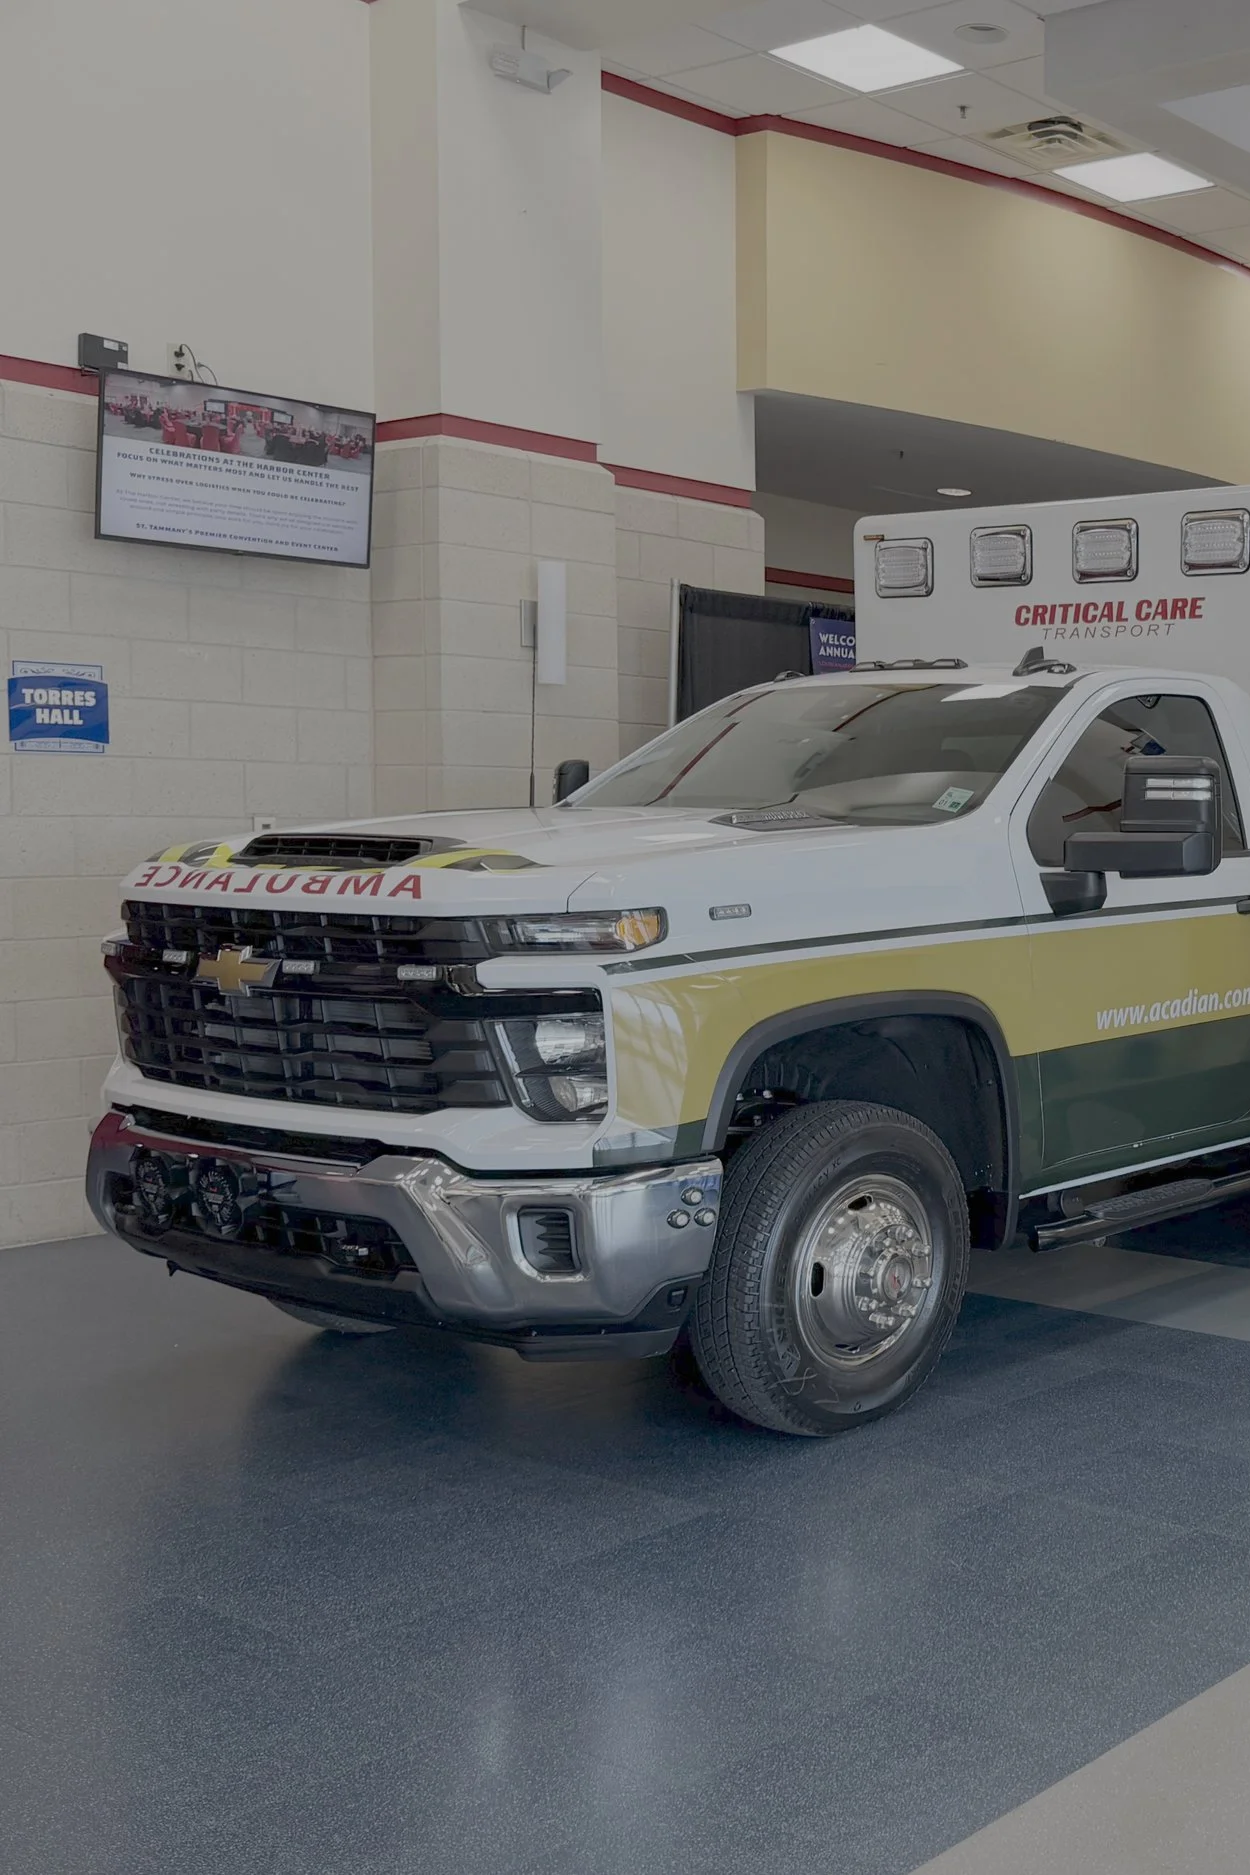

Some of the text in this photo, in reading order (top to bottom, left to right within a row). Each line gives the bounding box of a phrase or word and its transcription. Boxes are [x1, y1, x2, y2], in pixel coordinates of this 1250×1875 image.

[117, 451, 143, 462] FOCUS
[160, 458, 183, 467] WHAT
[186, 462, 223, 473] MATTERS
[225, 468, 247, 477] MOST
[249, 471, 265, 479] AND
[294, 478, 323, 487] HANDLE
[341, 485, 359, 493] REST
[149, 447, 330, 480] CELEBRATIONS AT THE HARBOR CENTER
[148, 475, 174, 483] STRESS
[175, 478, 193, 486] OVER
[195, 482, 230, 491] LOGISTICS
[231, 486, 251, 494] WHEN
[267, 491, 288, 499] COULD
[300, 496, 346, 506] CELEBRATING?
[149, 524, 193, 535] TAMMANY'S
[195, 530, 228, 539] PREMIER
[229, 533, 274, 545] CONVENTION
[313, 544, 339, 552] CENTER
[1014, 597, 1206, 626] CRITICAL CARE
[819, 632, 855, 647] WELCO
[1042, 623, 1175, 641] TRANSPORT
[819, 645, 855, 659] ANNUA
[21, 688, 96, 707] TORRES
[36, 708, 83, 725] HALL
